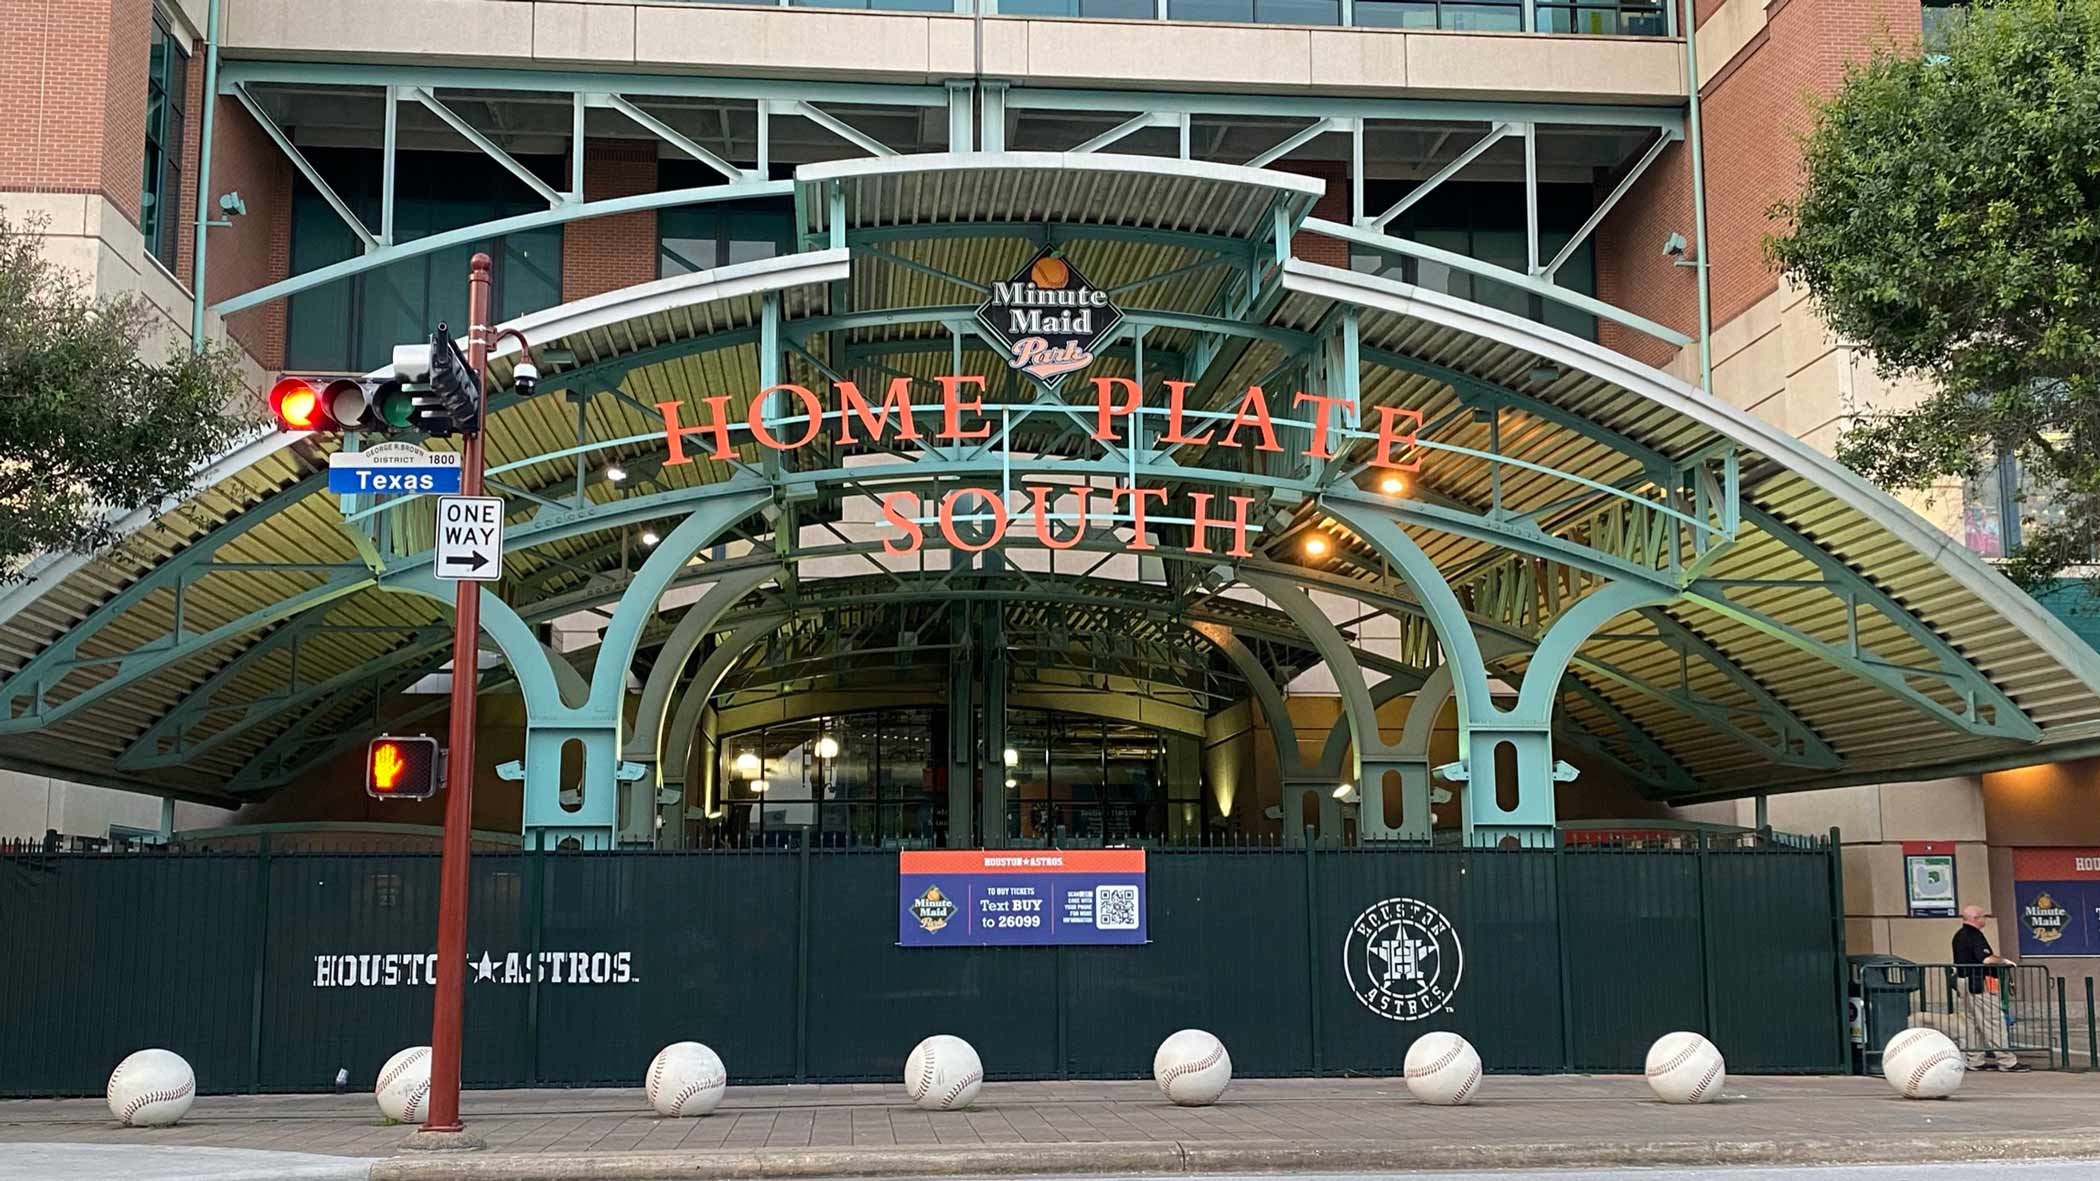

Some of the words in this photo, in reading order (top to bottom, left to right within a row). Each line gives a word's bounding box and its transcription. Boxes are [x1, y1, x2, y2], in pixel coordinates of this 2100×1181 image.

[991, 281, 1109, 308] Minute
[1008, 308, 1093, 335] Maid
[1008, 336, 1092, 371] Park
[654, 375, 992, 466] HOME
[1090, 377, 1424, 473] PLATE
[366, 443, 393, 458] GEORGE
[373, 456, 415, 464] DISTRICT
[429, 454, 455, 465] 1800
[356, 470, 434, 490] Texas
[447, 504, 495, 523] ONE
[882, 487, 1256, 557] SOUTH
[445, 527, 495, 546] WAY
[984, 857, 1022, 867] HOUSTON
[1030, 857, 1063, 867] ASTROS
[987, 887, 995, 896] TO
[1010, 887, 1035, 896] TICKETS
[914, 898, 953, 908] Minute
[980, 899, 1009, 912] Text
[1011, 899, 1043, 912] BUY
[919, 907, 947, 917] Maid
[2025, 905, 2066, 916] Minute
[982, 916, 995, 928] to
[998, 915, 1041, 928] 26099
[2031, 916, 2061, 927] Maid
[313, 953, 439, 987] HOUSTO
